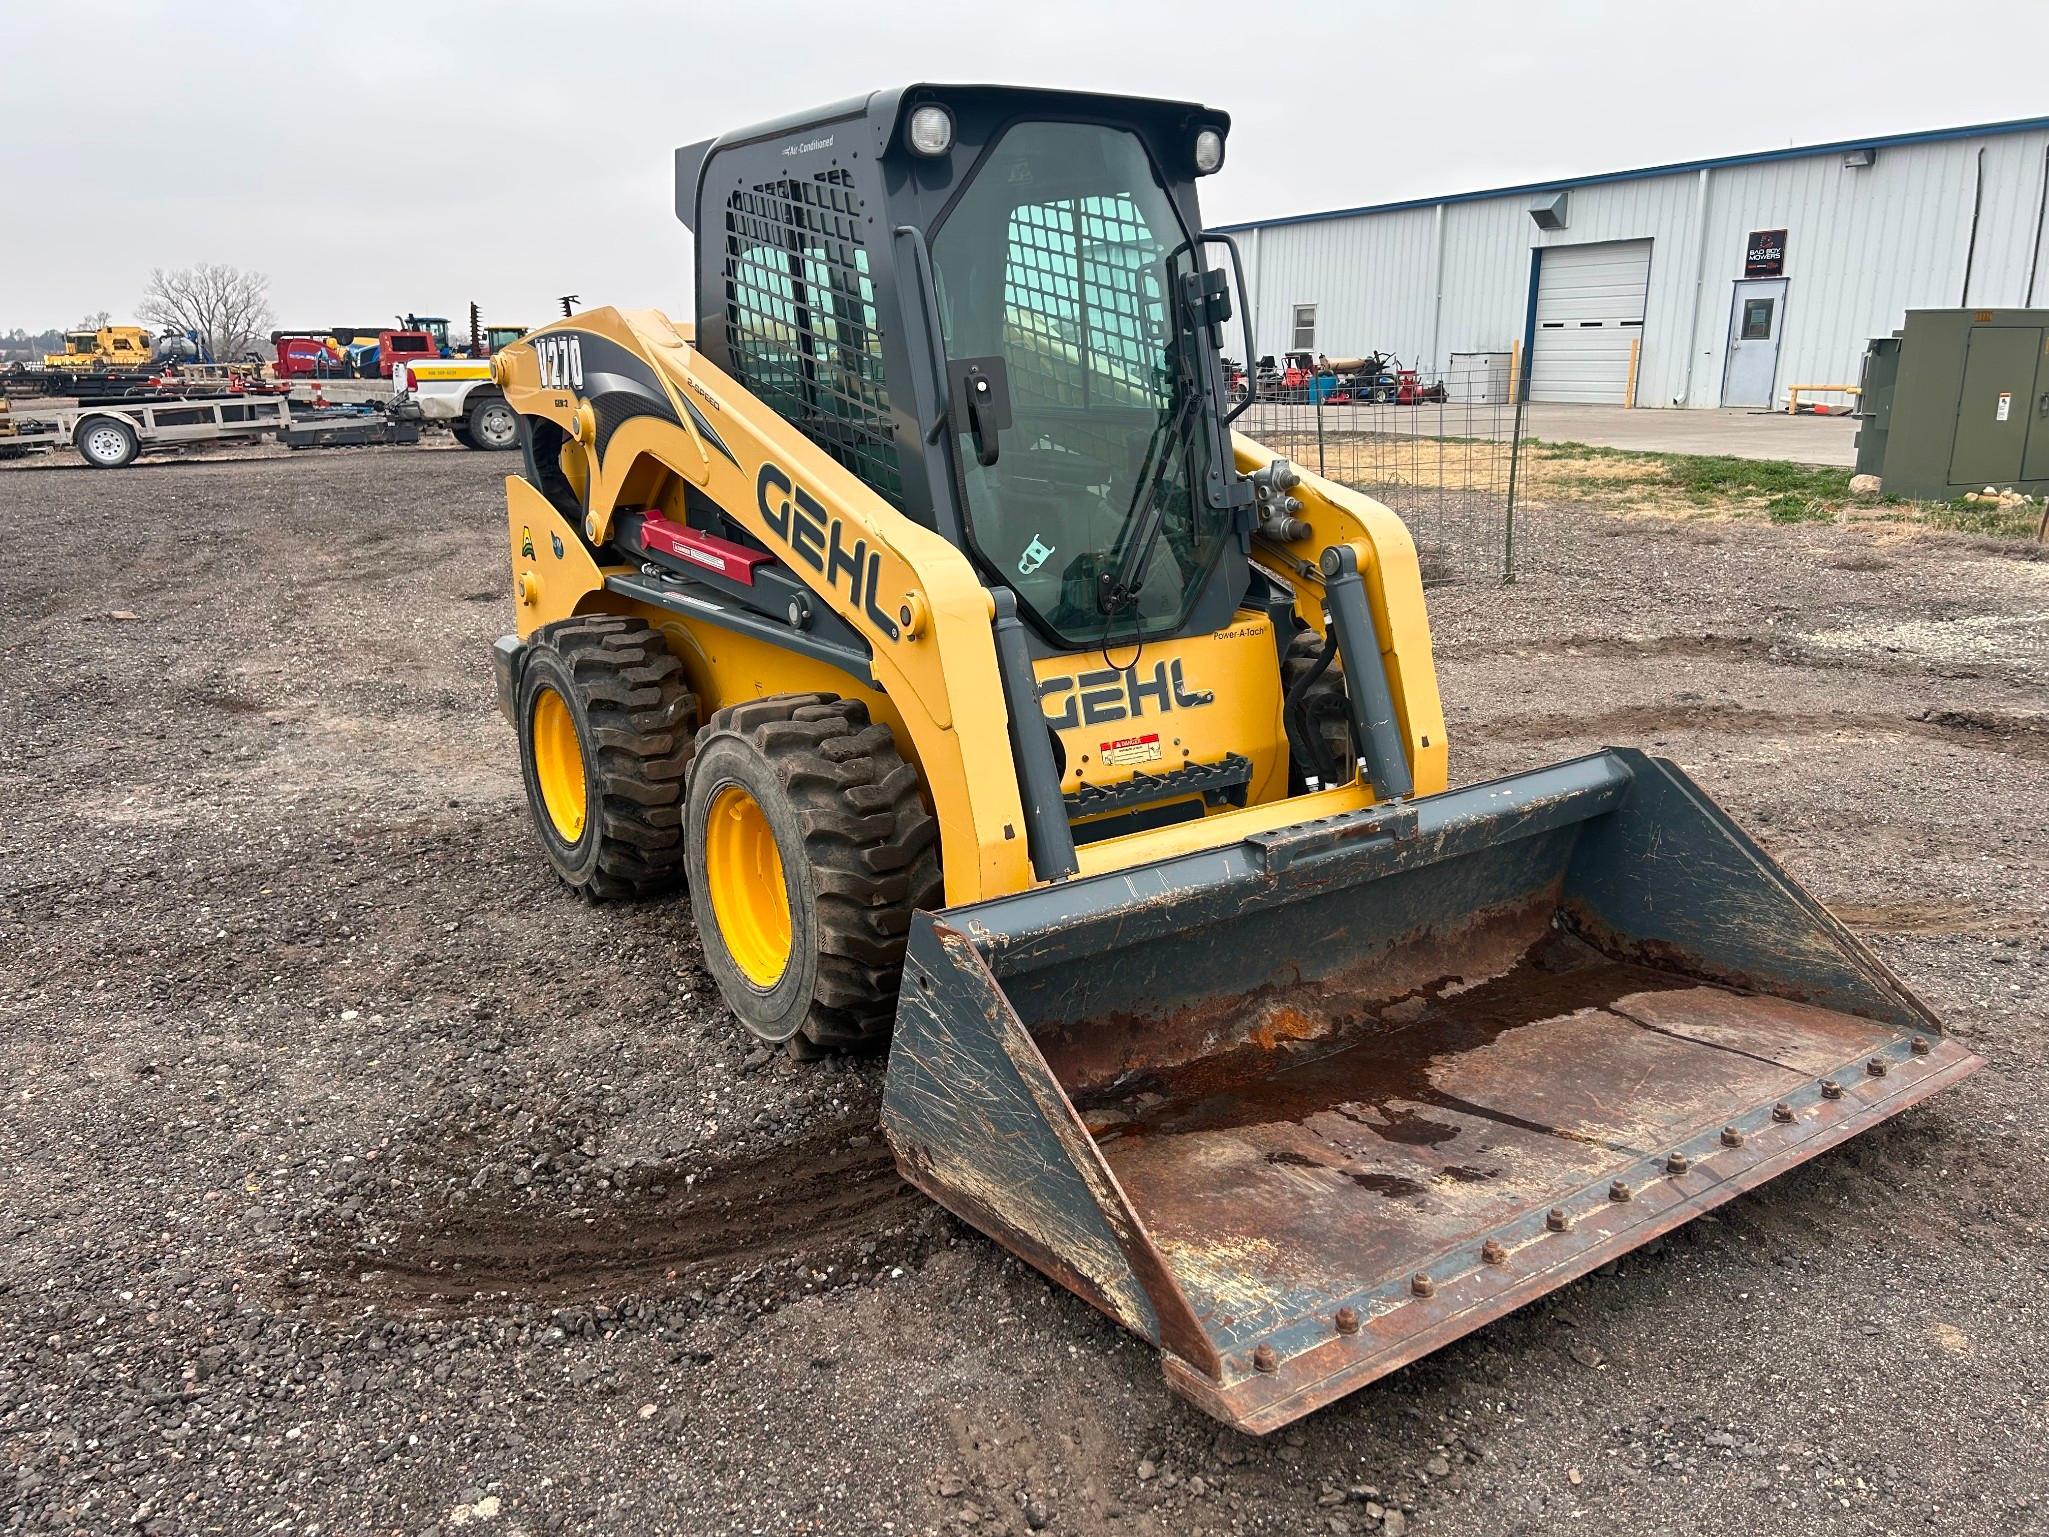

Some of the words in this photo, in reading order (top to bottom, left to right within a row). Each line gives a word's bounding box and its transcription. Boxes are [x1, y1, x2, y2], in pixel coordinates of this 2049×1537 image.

[1749, 253, 1781, 261] MOWERS
[535, 334, 583, 390] V270
[756, 461, 900, 642] GEHL
[1038, 657, 1214, 731] GEHL
